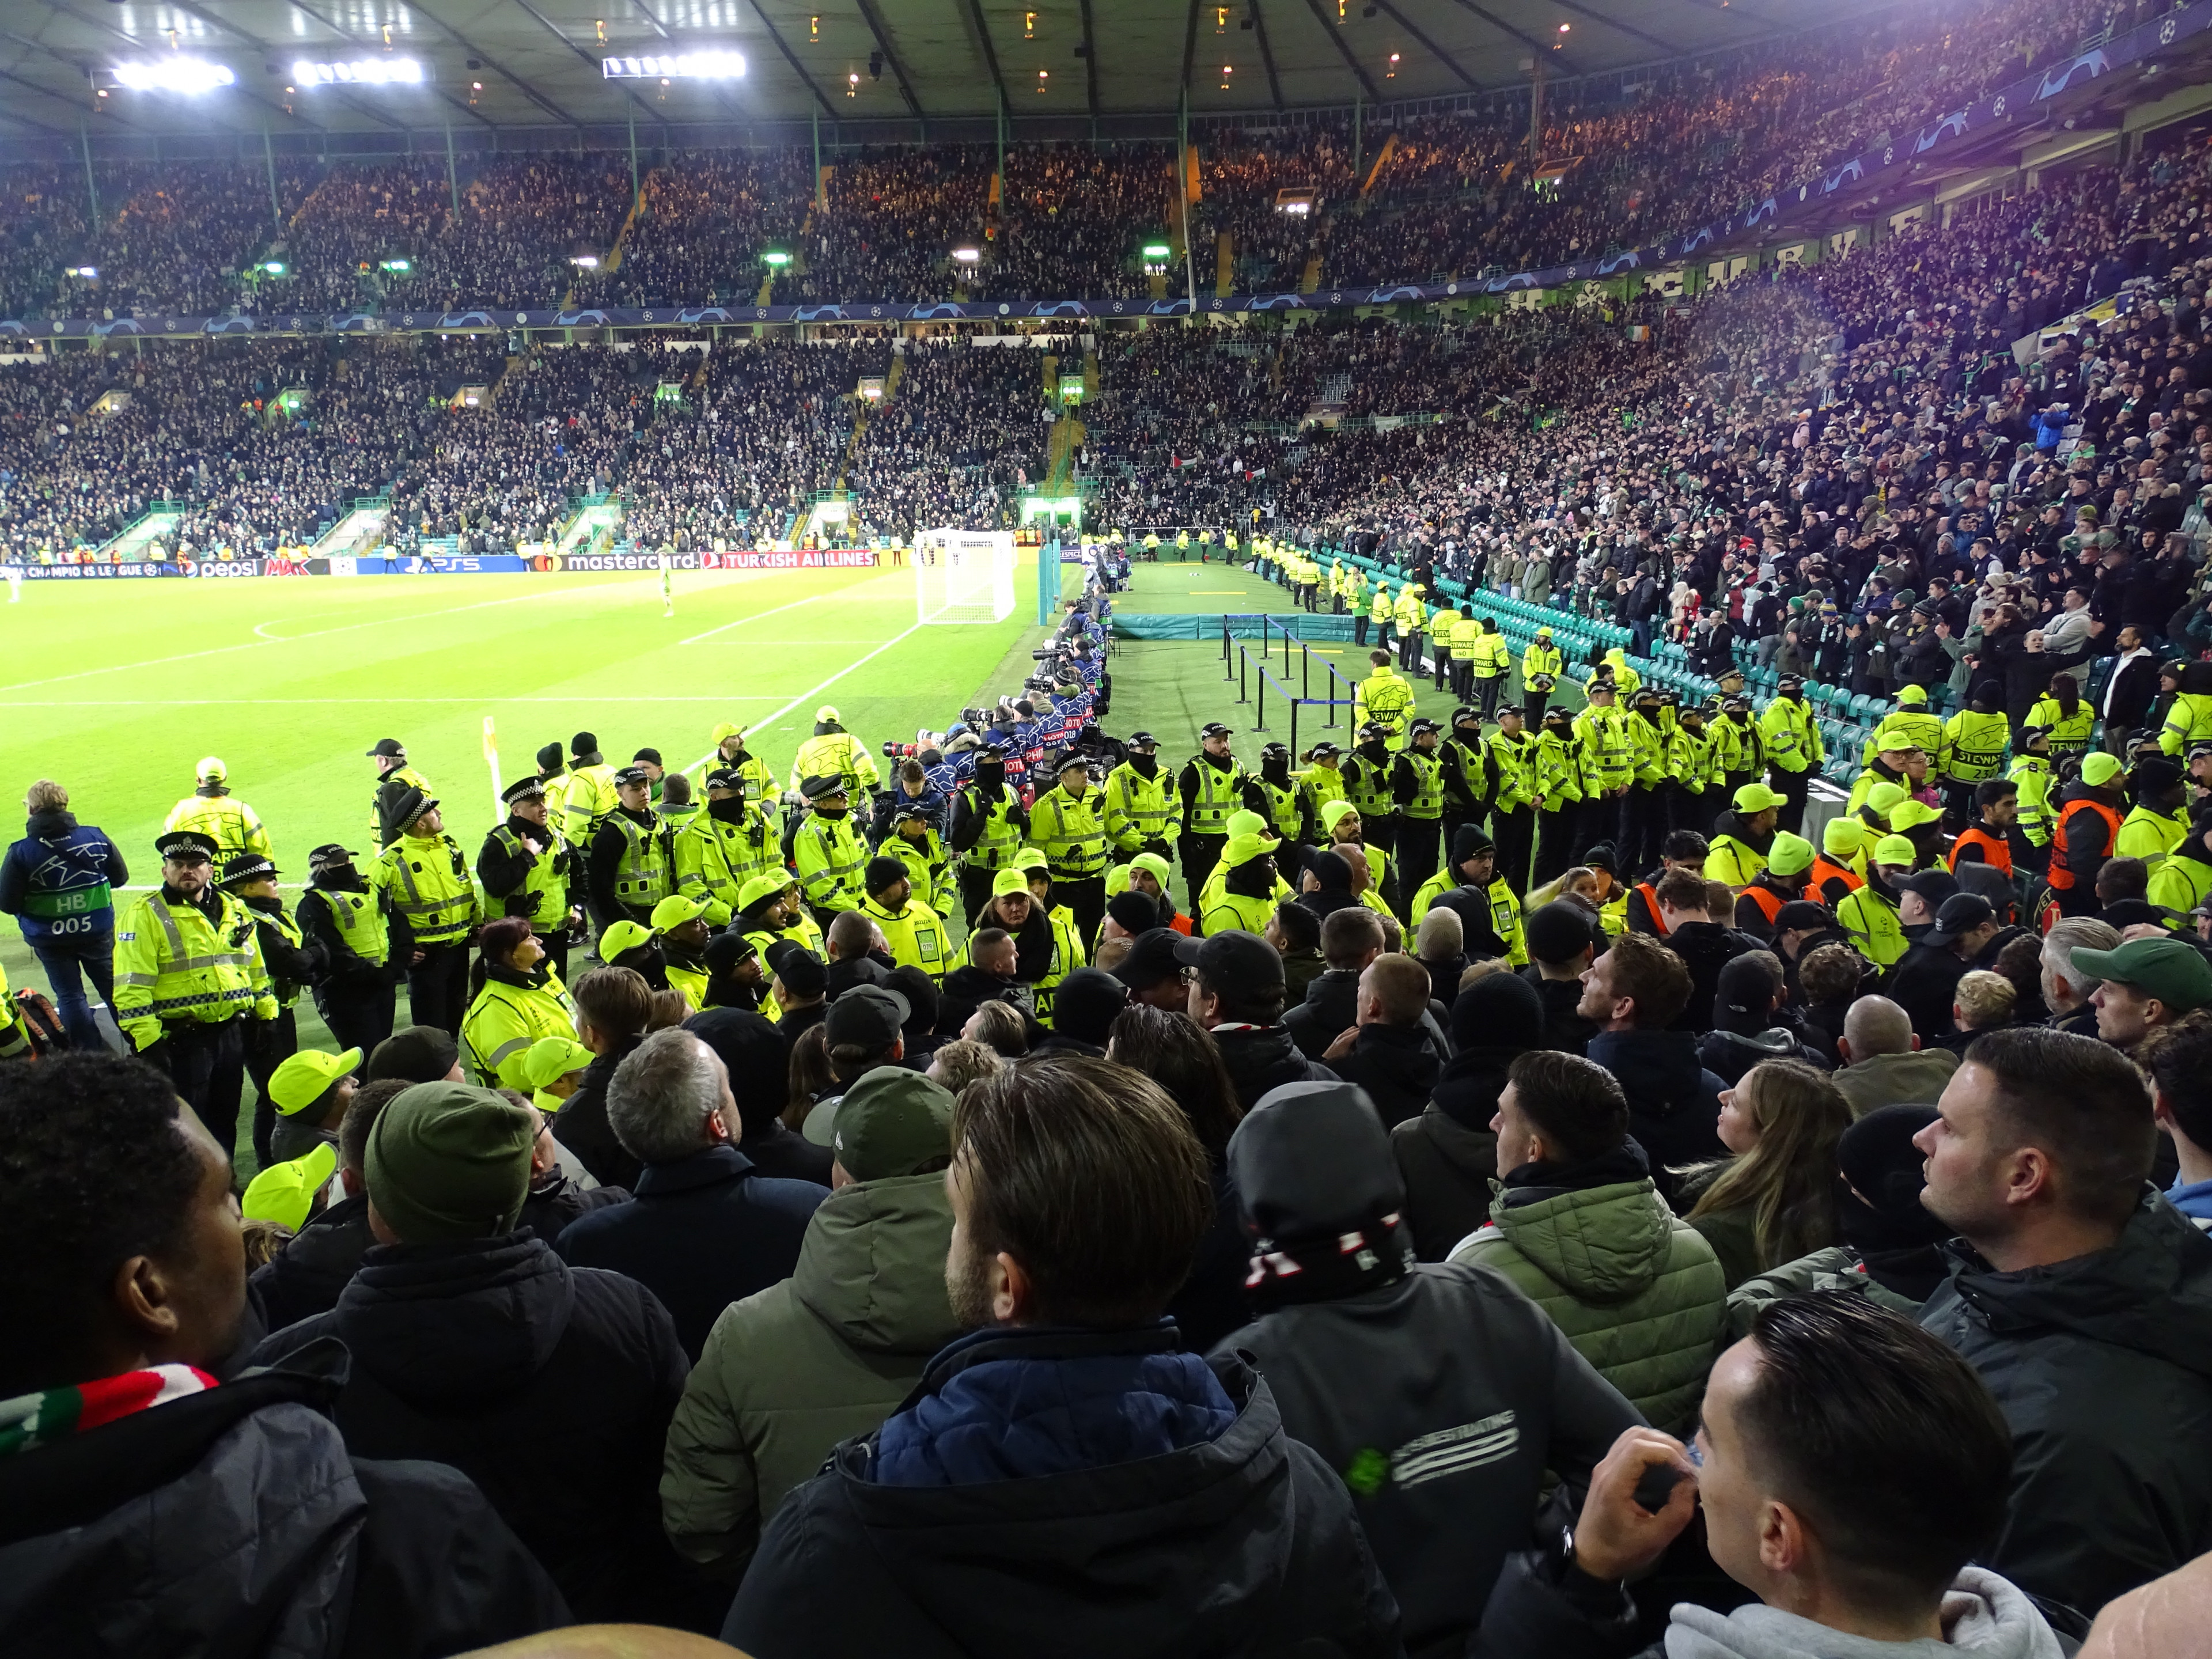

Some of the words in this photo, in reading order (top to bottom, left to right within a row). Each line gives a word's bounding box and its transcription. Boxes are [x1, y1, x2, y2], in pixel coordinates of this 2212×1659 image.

[431, 558, 480, 571] PS5
[726, 554, 797, 568] TURKISH
[802, 552, 874, 567] AIRLINES
[29, 565, 96, 578] CHAMPIOS
[201, 559, 258, 578] pepsi
[1065, 718, 1080, 728] HOTO
[1004, 760, 1024, 772] OTO
[1008, 774, 1020, 783] 17
[56, 894, 86, 913] HB
[51, 915, 92, 935] 005
